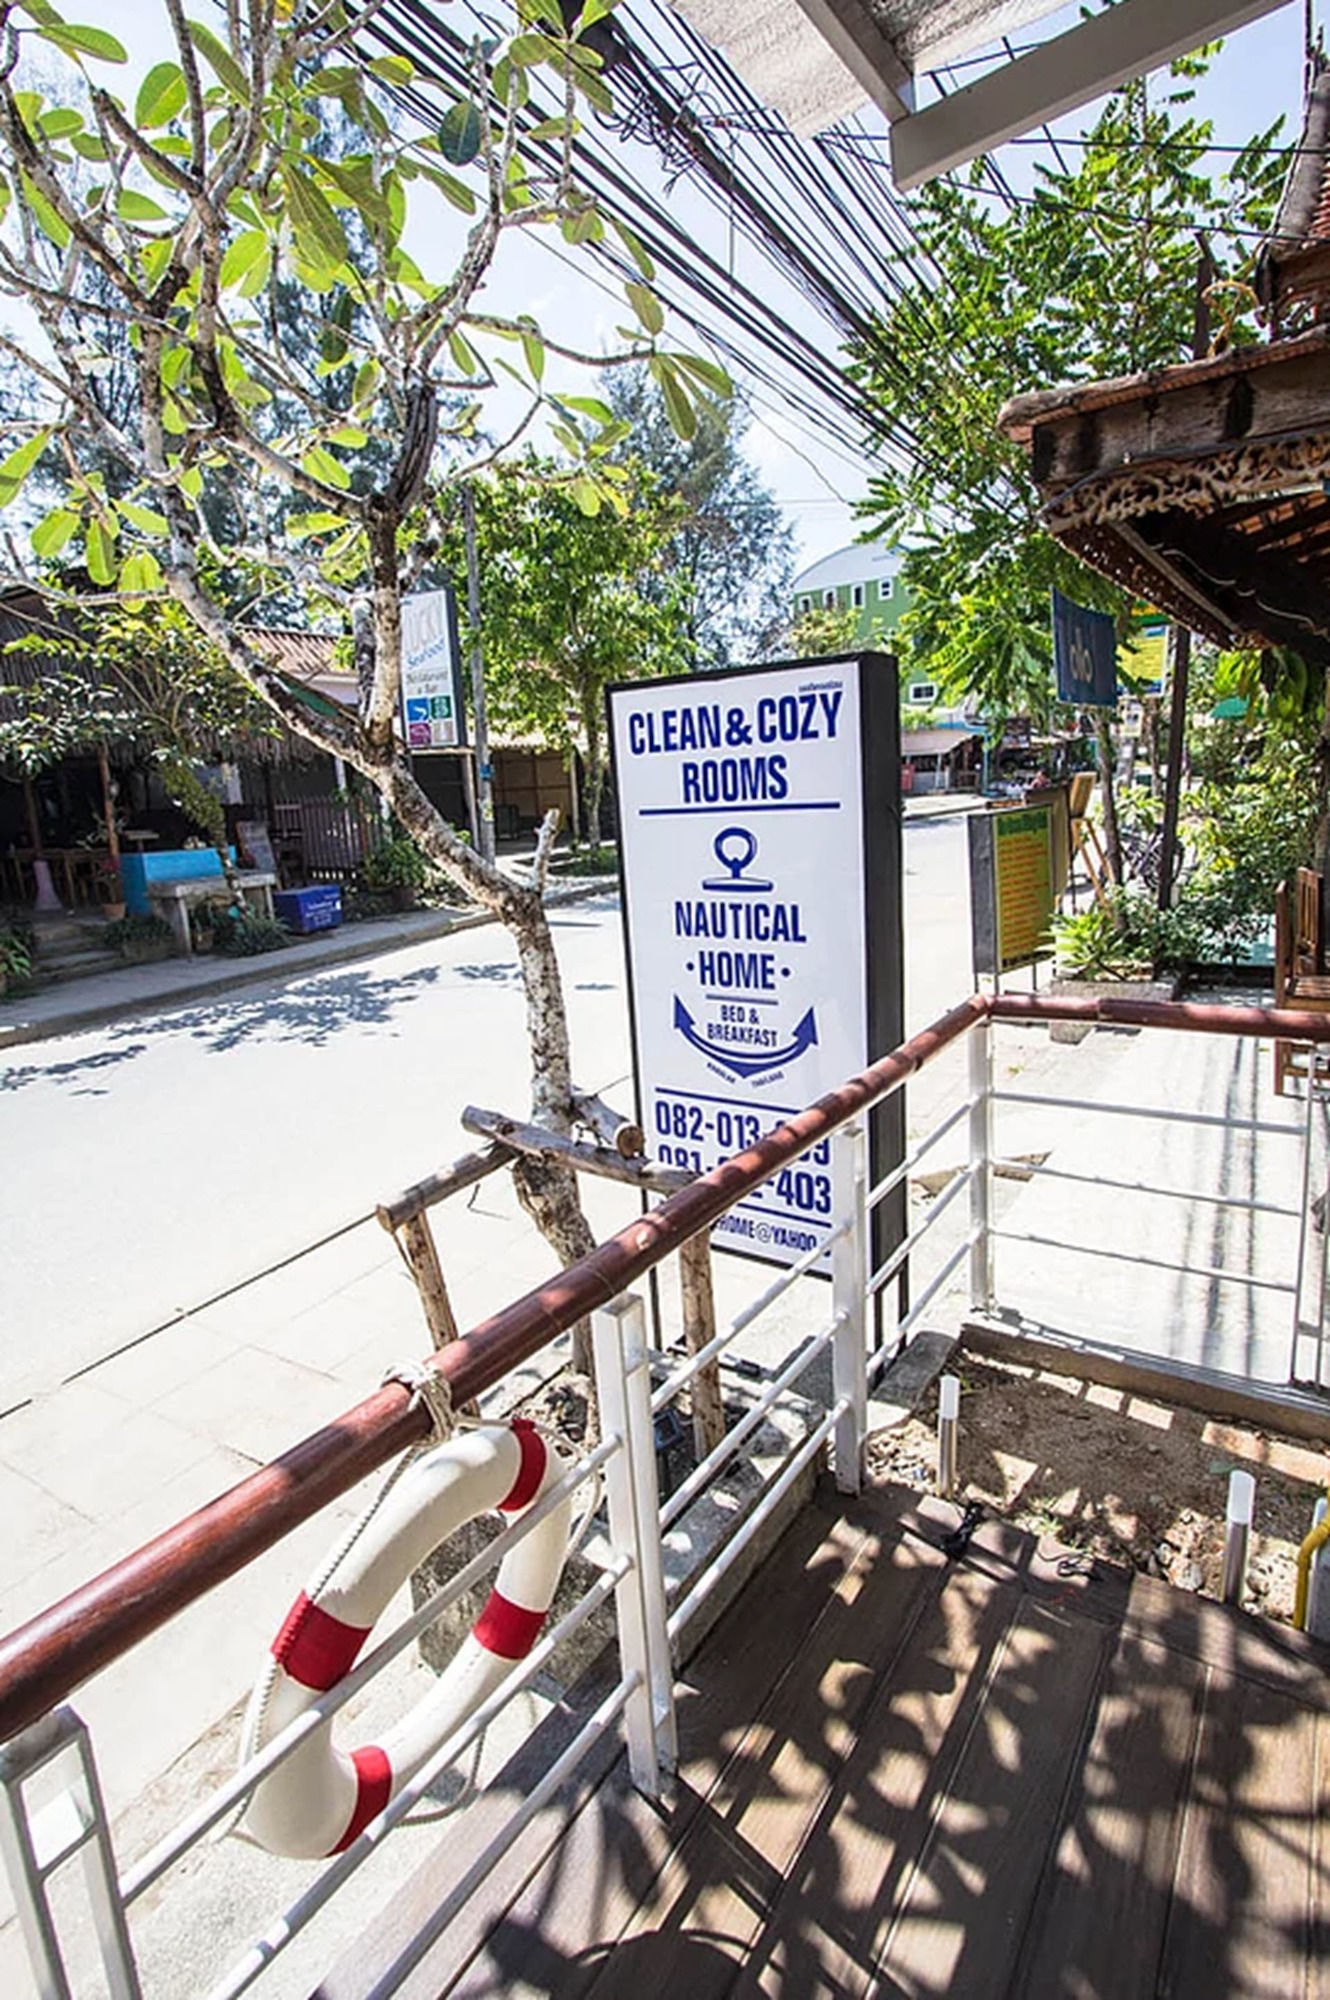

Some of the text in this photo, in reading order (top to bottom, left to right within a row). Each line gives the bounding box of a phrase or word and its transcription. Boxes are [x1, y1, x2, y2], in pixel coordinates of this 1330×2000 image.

[628, 690, 843, 756] CLEAN & COZY
[682, 754, 788, 804] ROOMS
[675, 901, 807, 943] NAUTICAL
[698, 950, 776, 990] HOME
[707, 1022, 777, 1047] BREAKFAST
[721, 1004, 760, 1025] BED &
